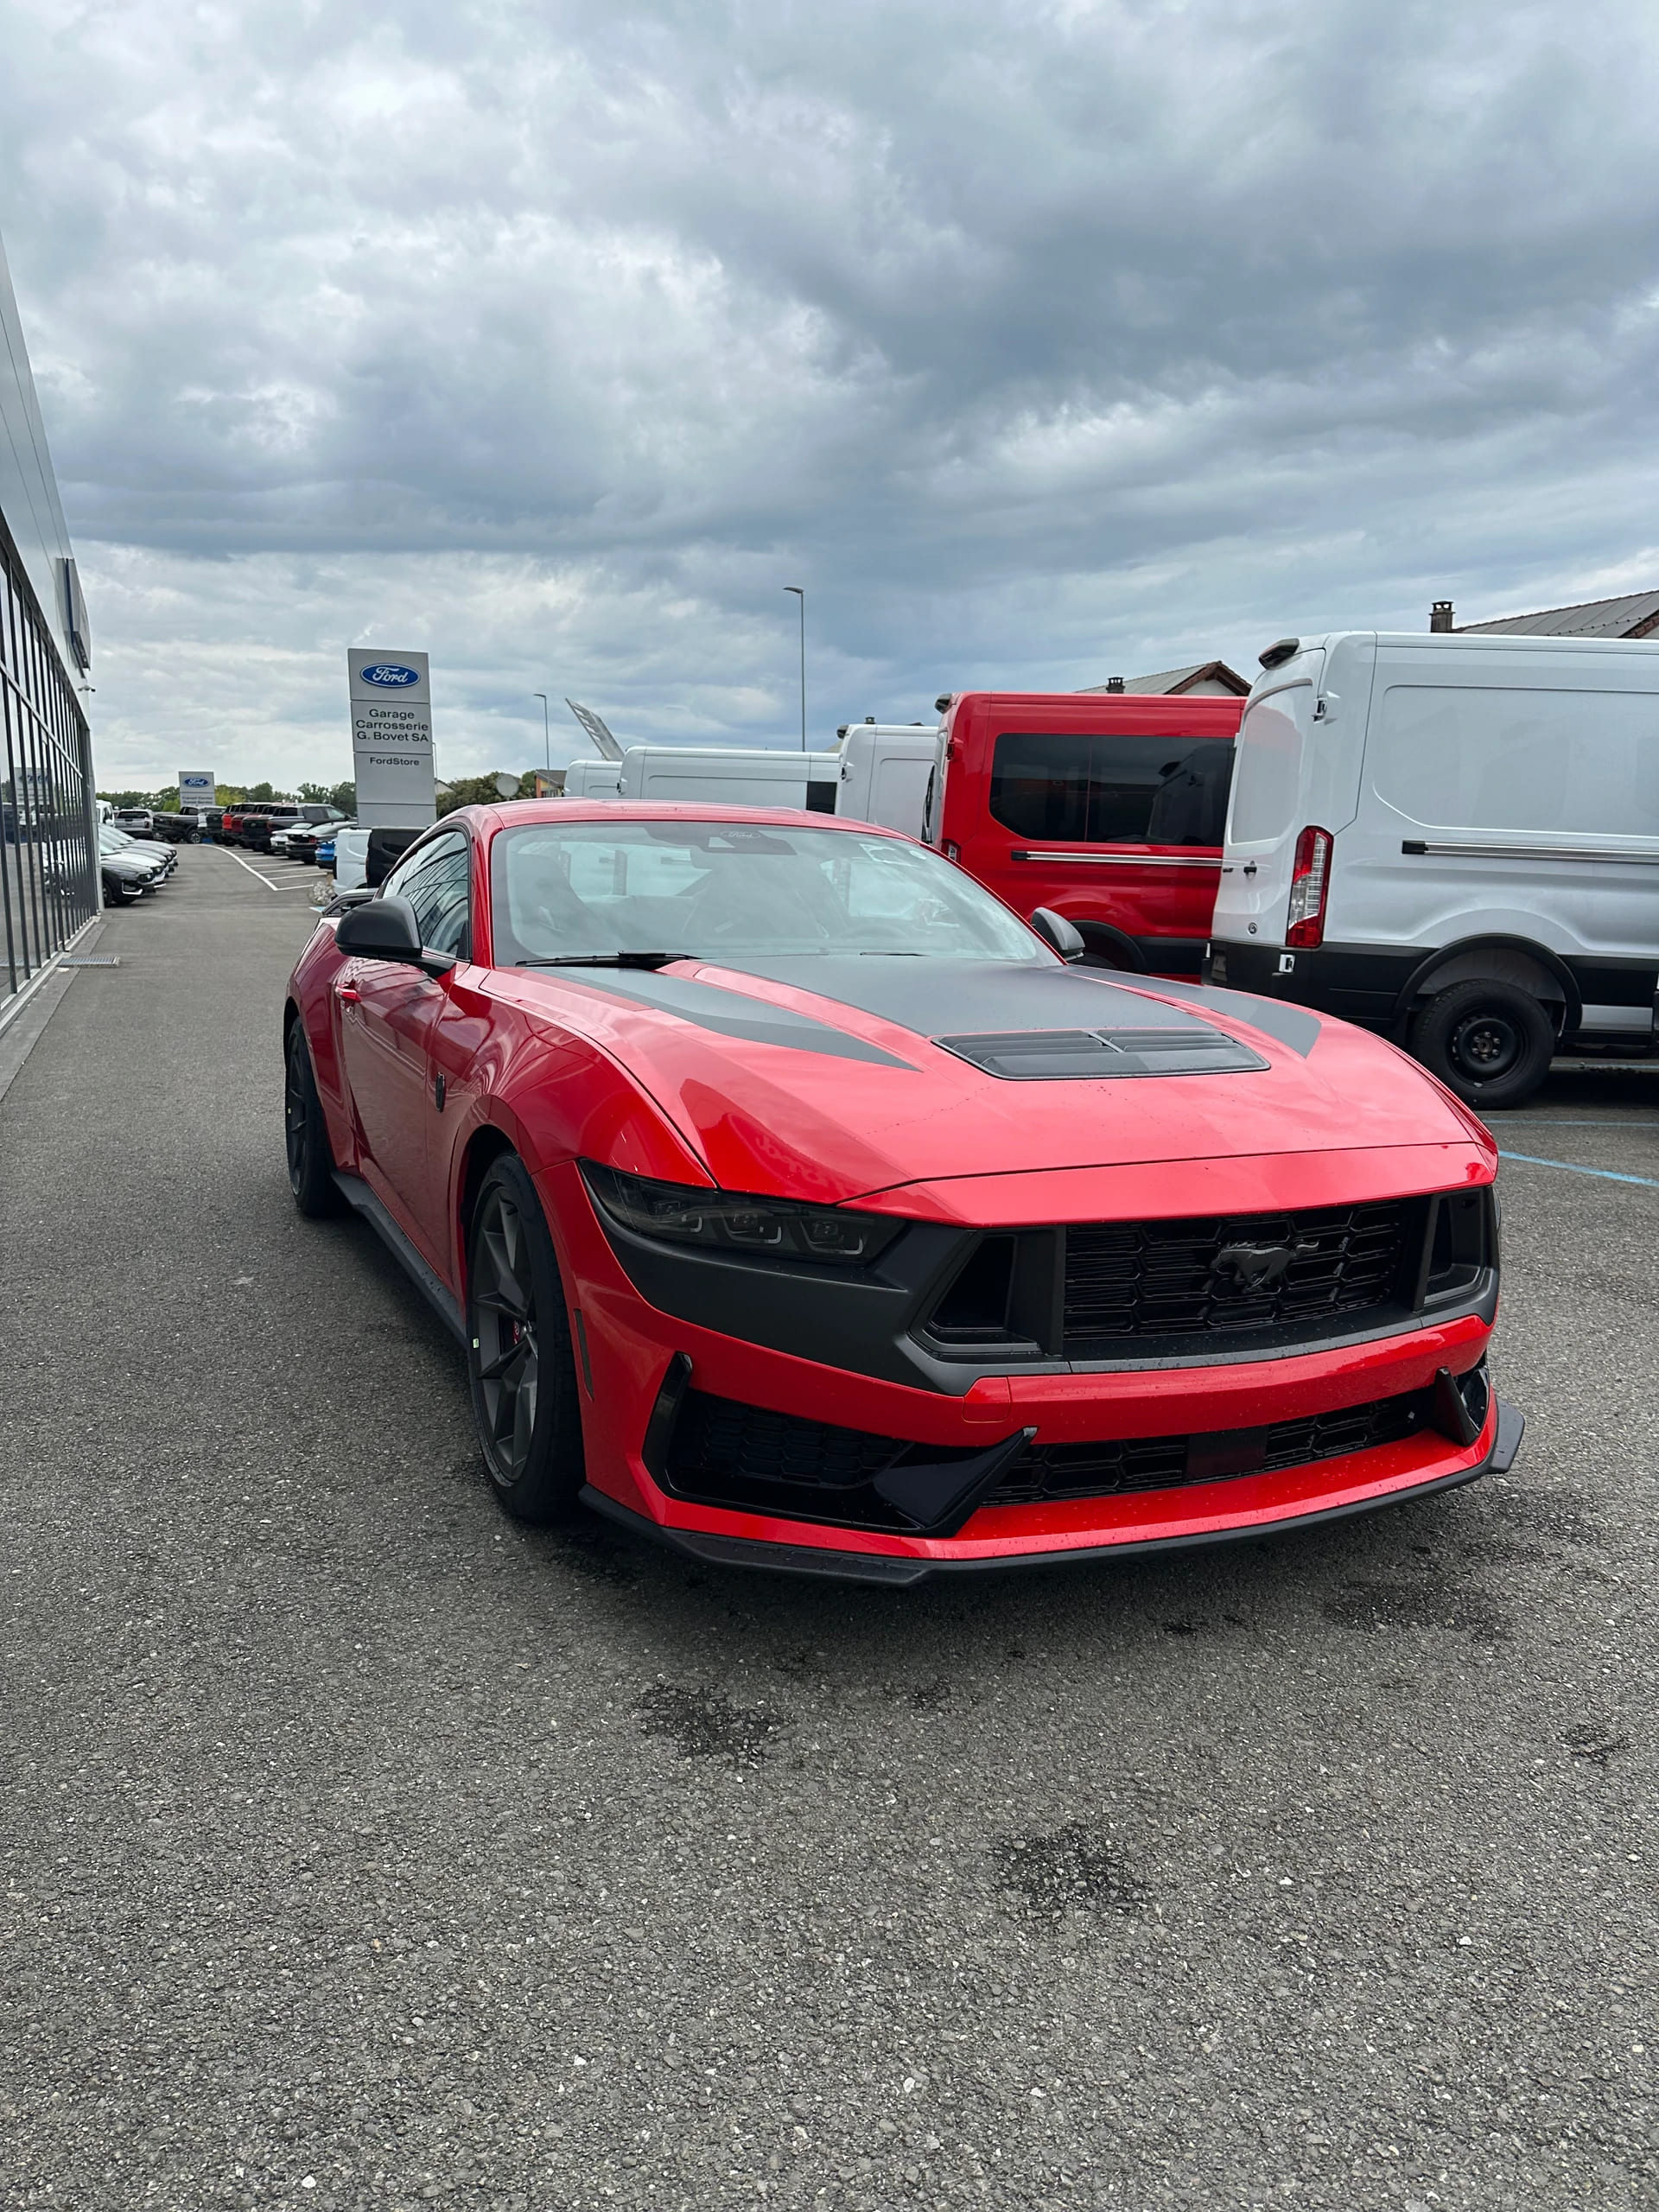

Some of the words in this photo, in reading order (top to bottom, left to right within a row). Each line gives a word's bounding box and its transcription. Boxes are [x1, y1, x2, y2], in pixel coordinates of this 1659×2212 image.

[372, 666, 409, 683] Ford
[369, 709, 415, 721] Garage
[356, 720, 429, 731] Carrosserie
[357, 731, 371, 740] G.
[373, 732, 409, 741] Bovet
[411, 733, 429, 742] SA
[370, 757, 420, 766] FordStore
